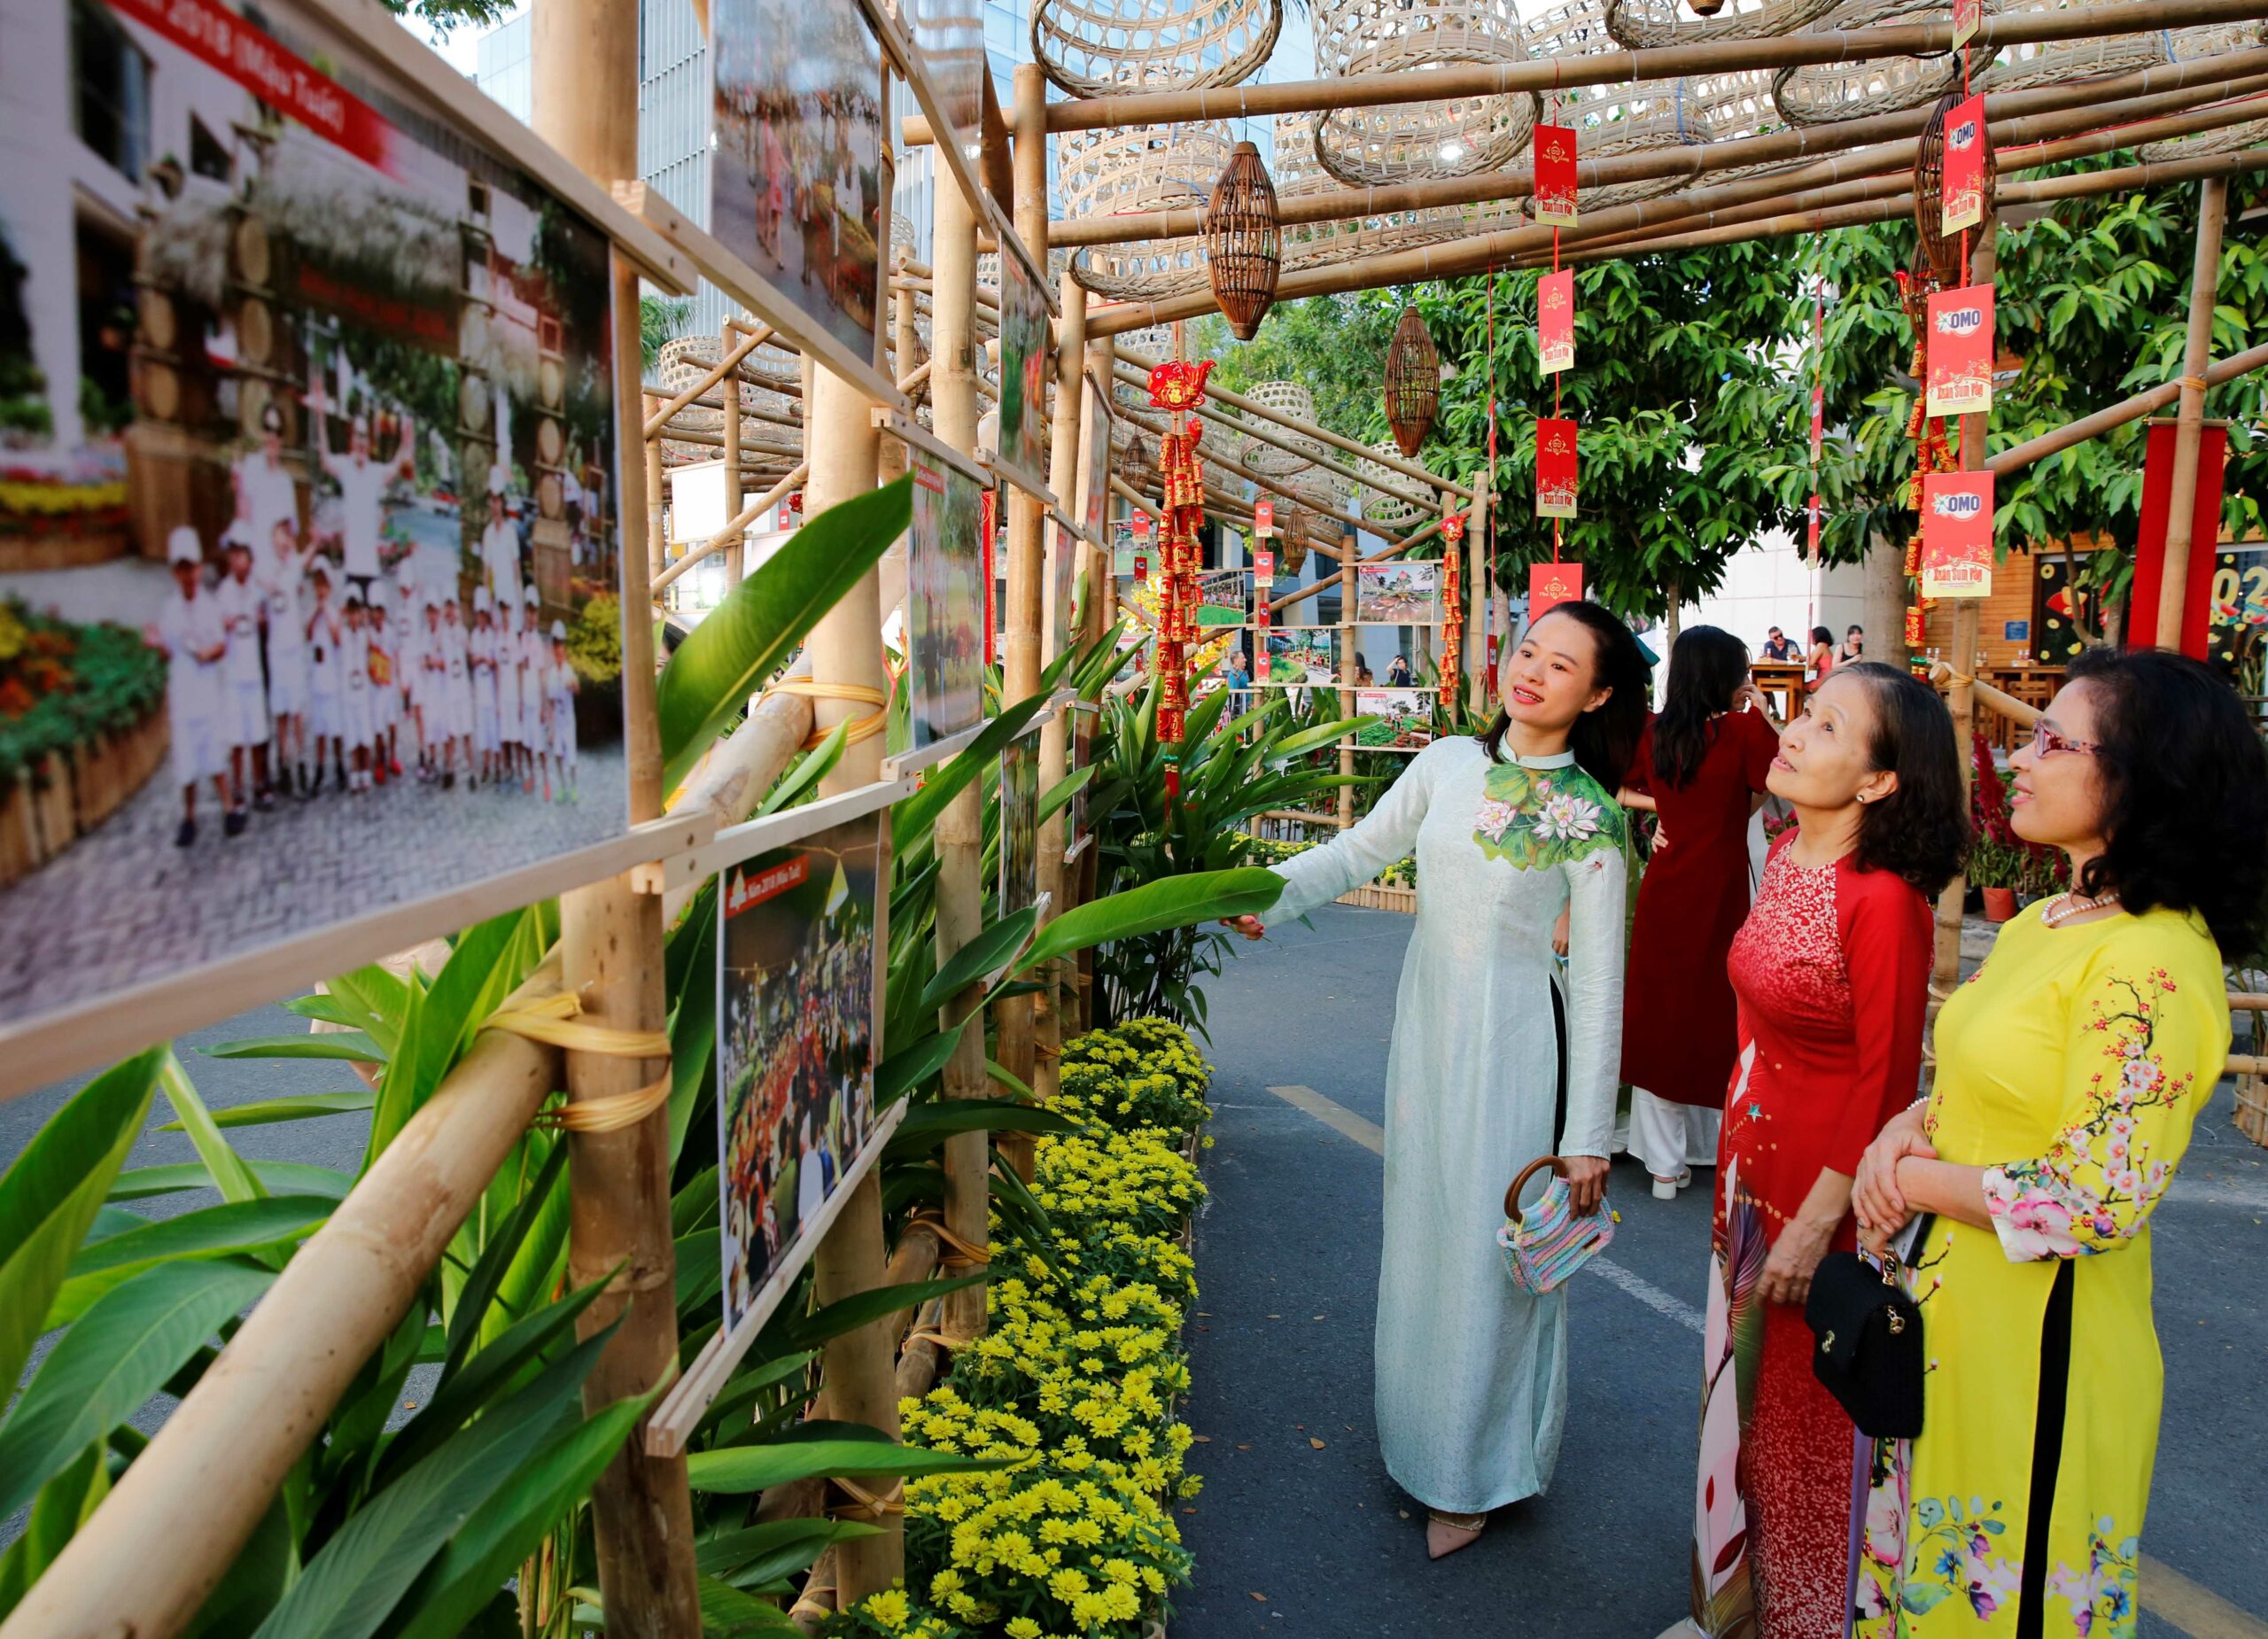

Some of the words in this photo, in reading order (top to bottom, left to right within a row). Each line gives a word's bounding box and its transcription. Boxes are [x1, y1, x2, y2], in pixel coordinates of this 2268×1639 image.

[1957, 122, 1975, 144] OMO
[1950, 310, 1981, 329] OMO
[1947, 495, 1980, 512] OMO
